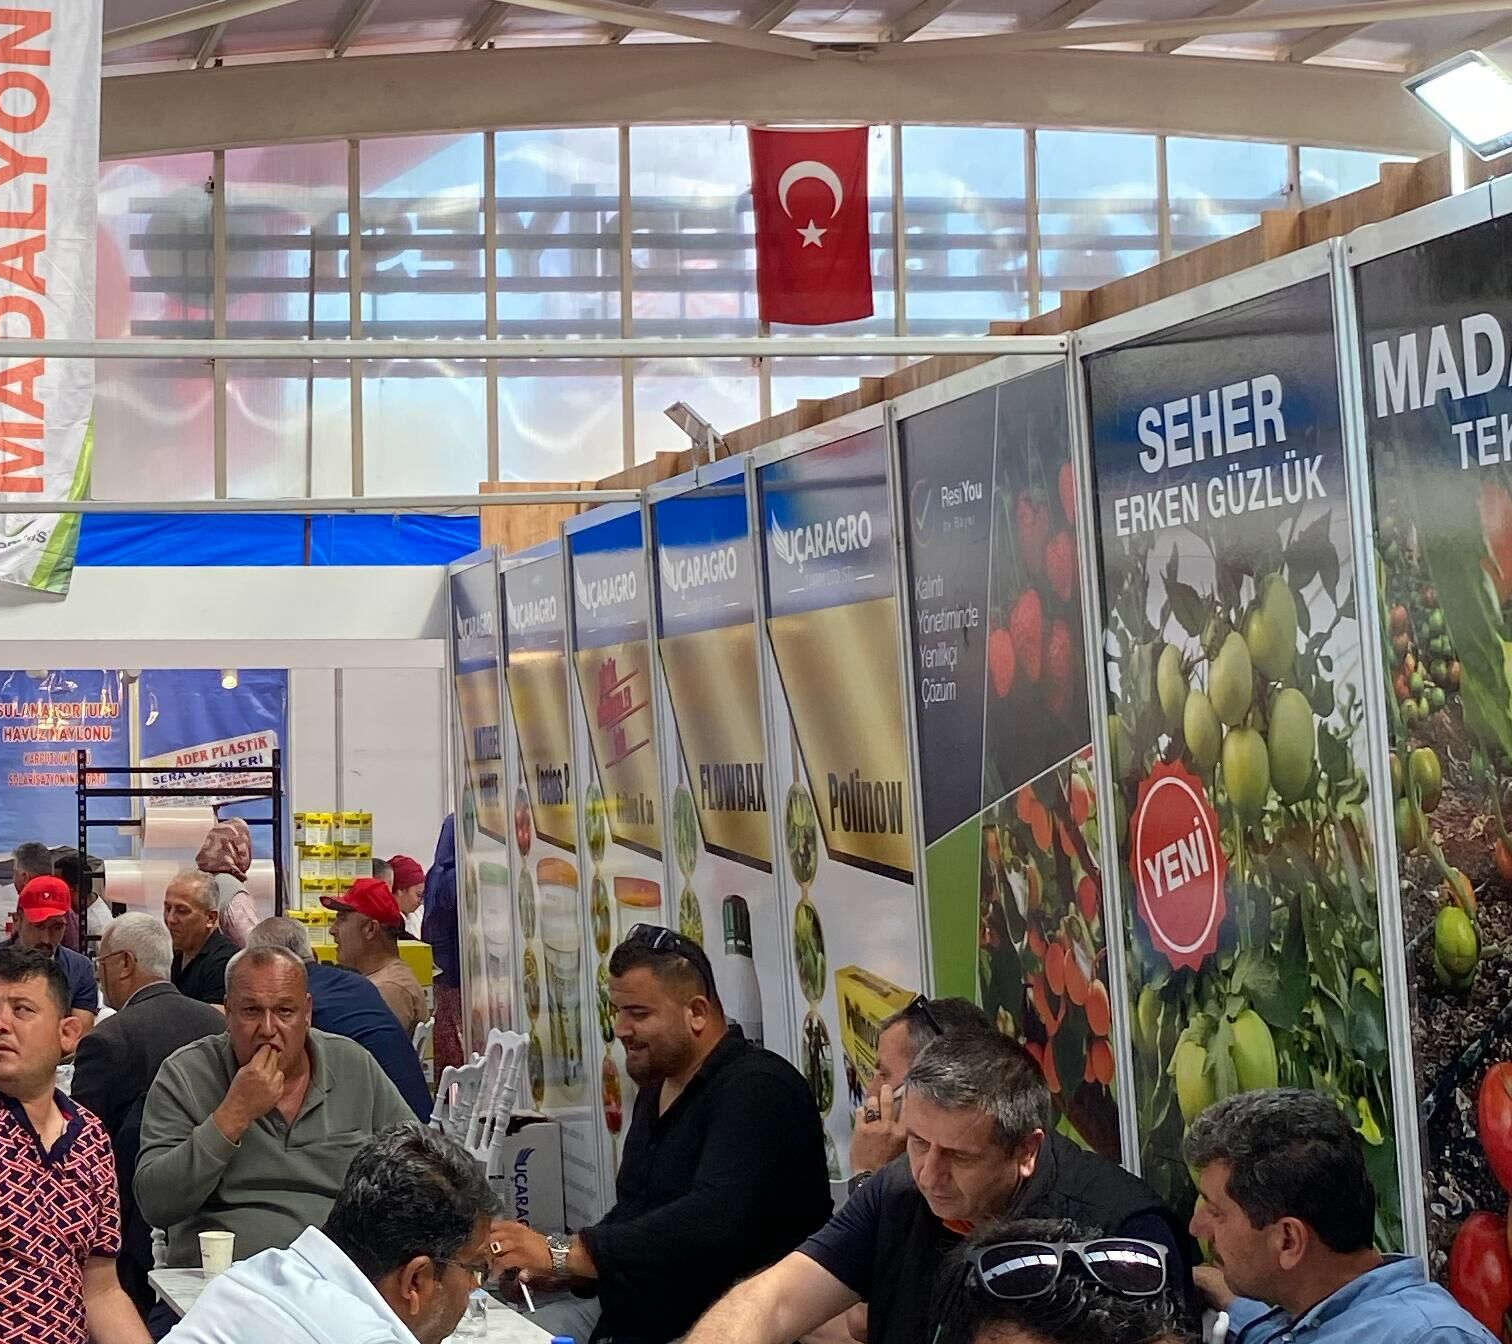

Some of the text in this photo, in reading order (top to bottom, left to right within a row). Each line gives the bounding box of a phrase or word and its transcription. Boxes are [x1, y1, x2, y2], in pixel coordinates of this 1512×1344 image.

[1372, 312, 1512, 419] MAD
[1136, 373, 1287, 475] SEHER
[941, 480, 983, 508] ResiYou
[1113, 454, 1328, 538] ERKEN GÜZLÜK
[671, 546, 737, 600] UÇARAGRO
[785, 510, 872, 574] UÇARAGRO
[175, 735, 268, 768] ADER PLASTİK
[699, 763, 767, 812] FLOWBAX
[828, 769, 903, 835] Polinow
[1142, 816, 1211, 901] YENİ
